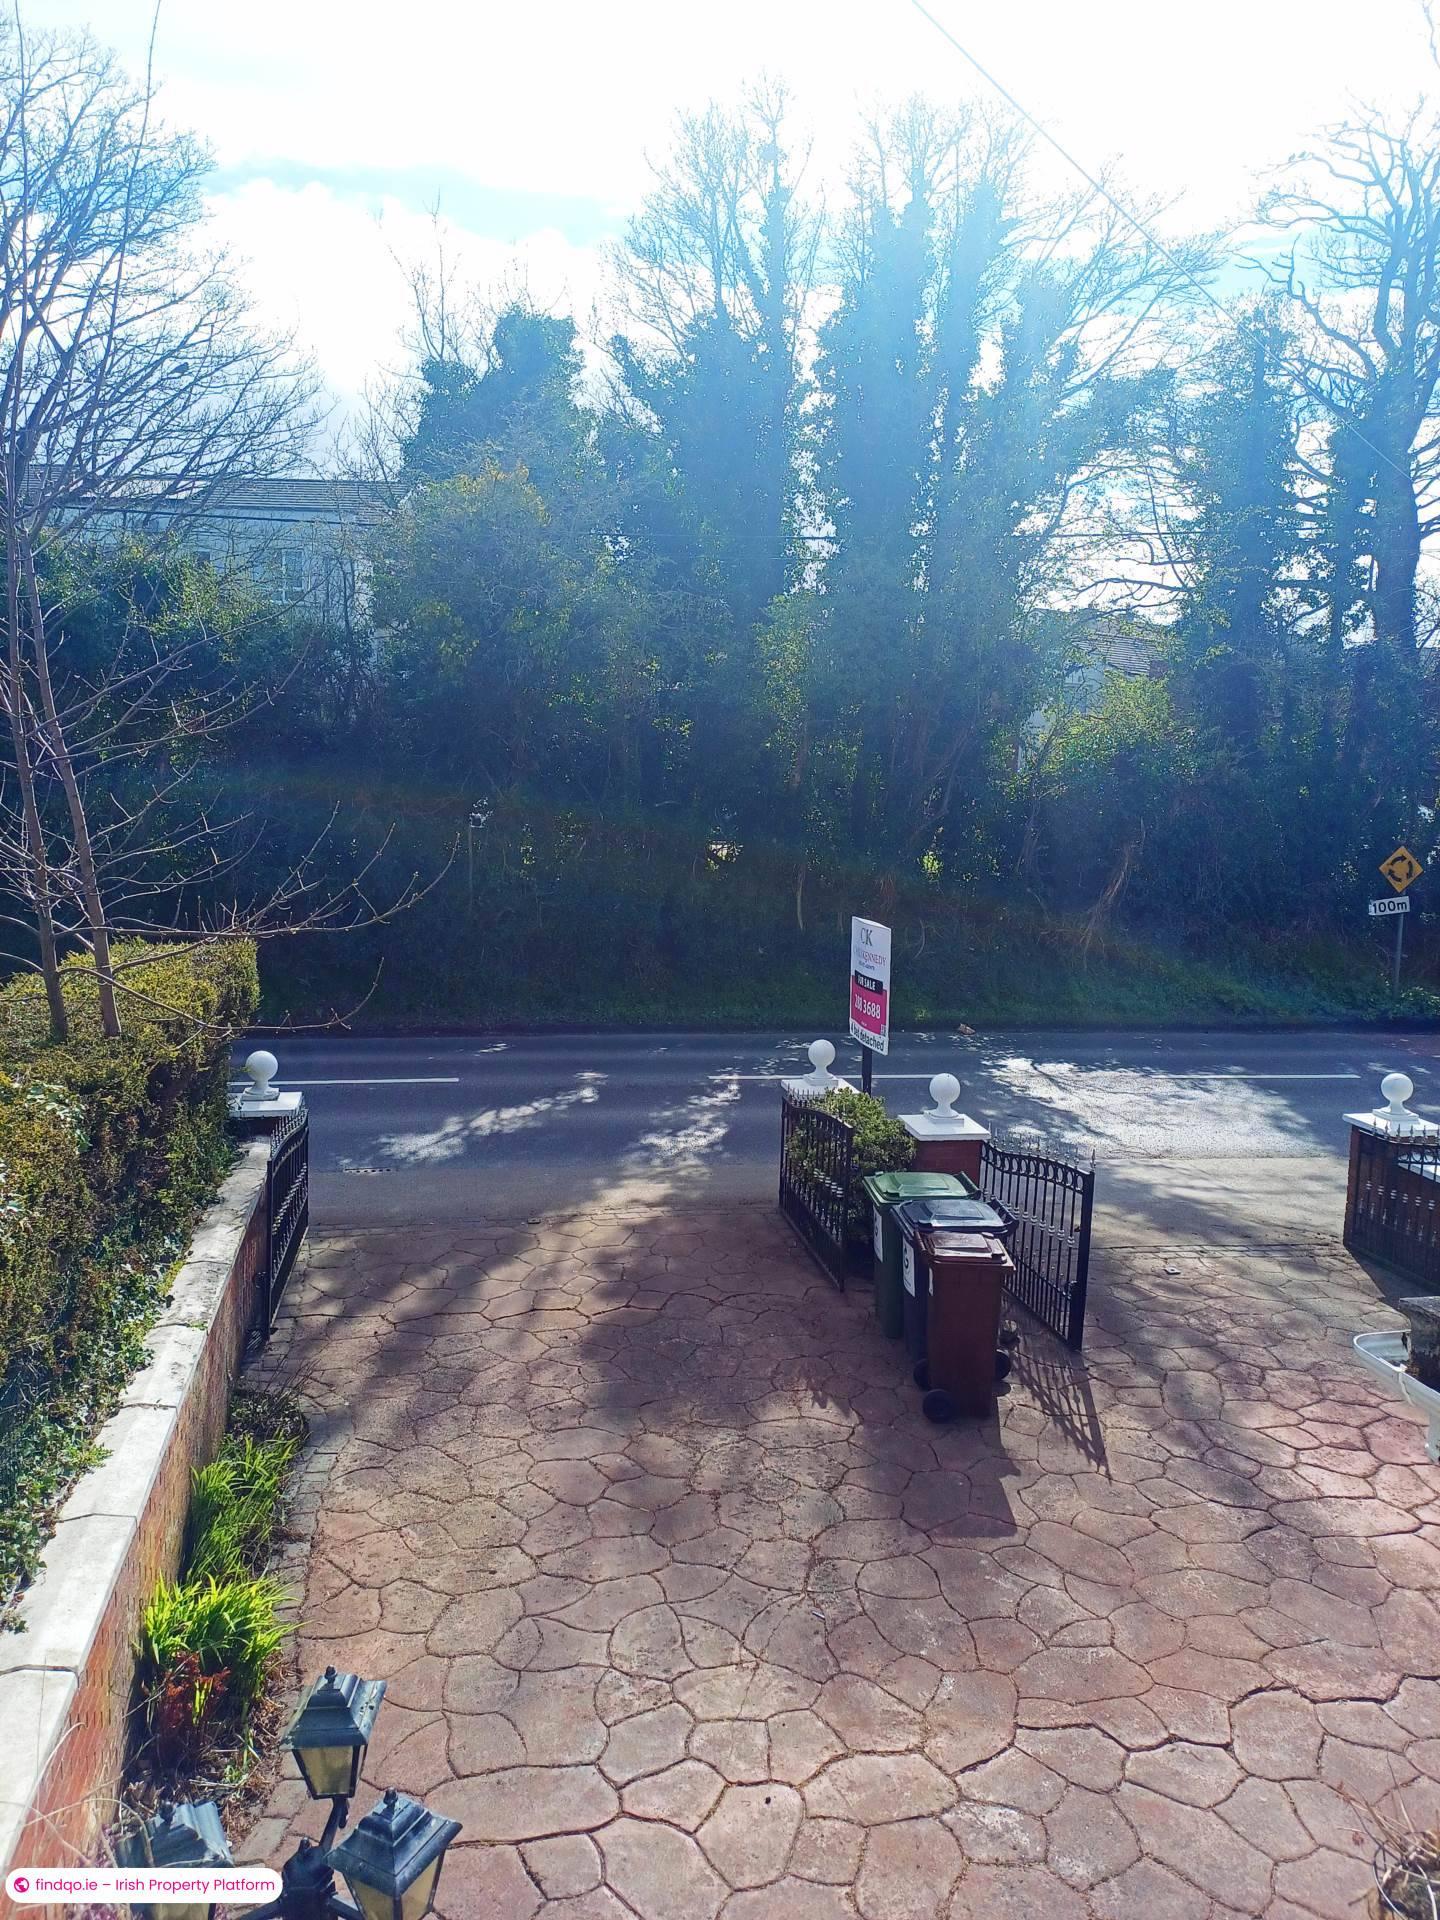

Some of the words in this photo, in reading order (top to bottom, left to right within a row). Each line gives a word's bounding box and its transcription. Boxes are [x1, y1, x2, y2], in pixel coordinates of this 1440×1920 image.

[1373, 900, 1407, 913] 100m
[861, 928, 873, 946] CK
[864, 978, 876, 991] SALE
[863, 999, 881, 1019] 3688
